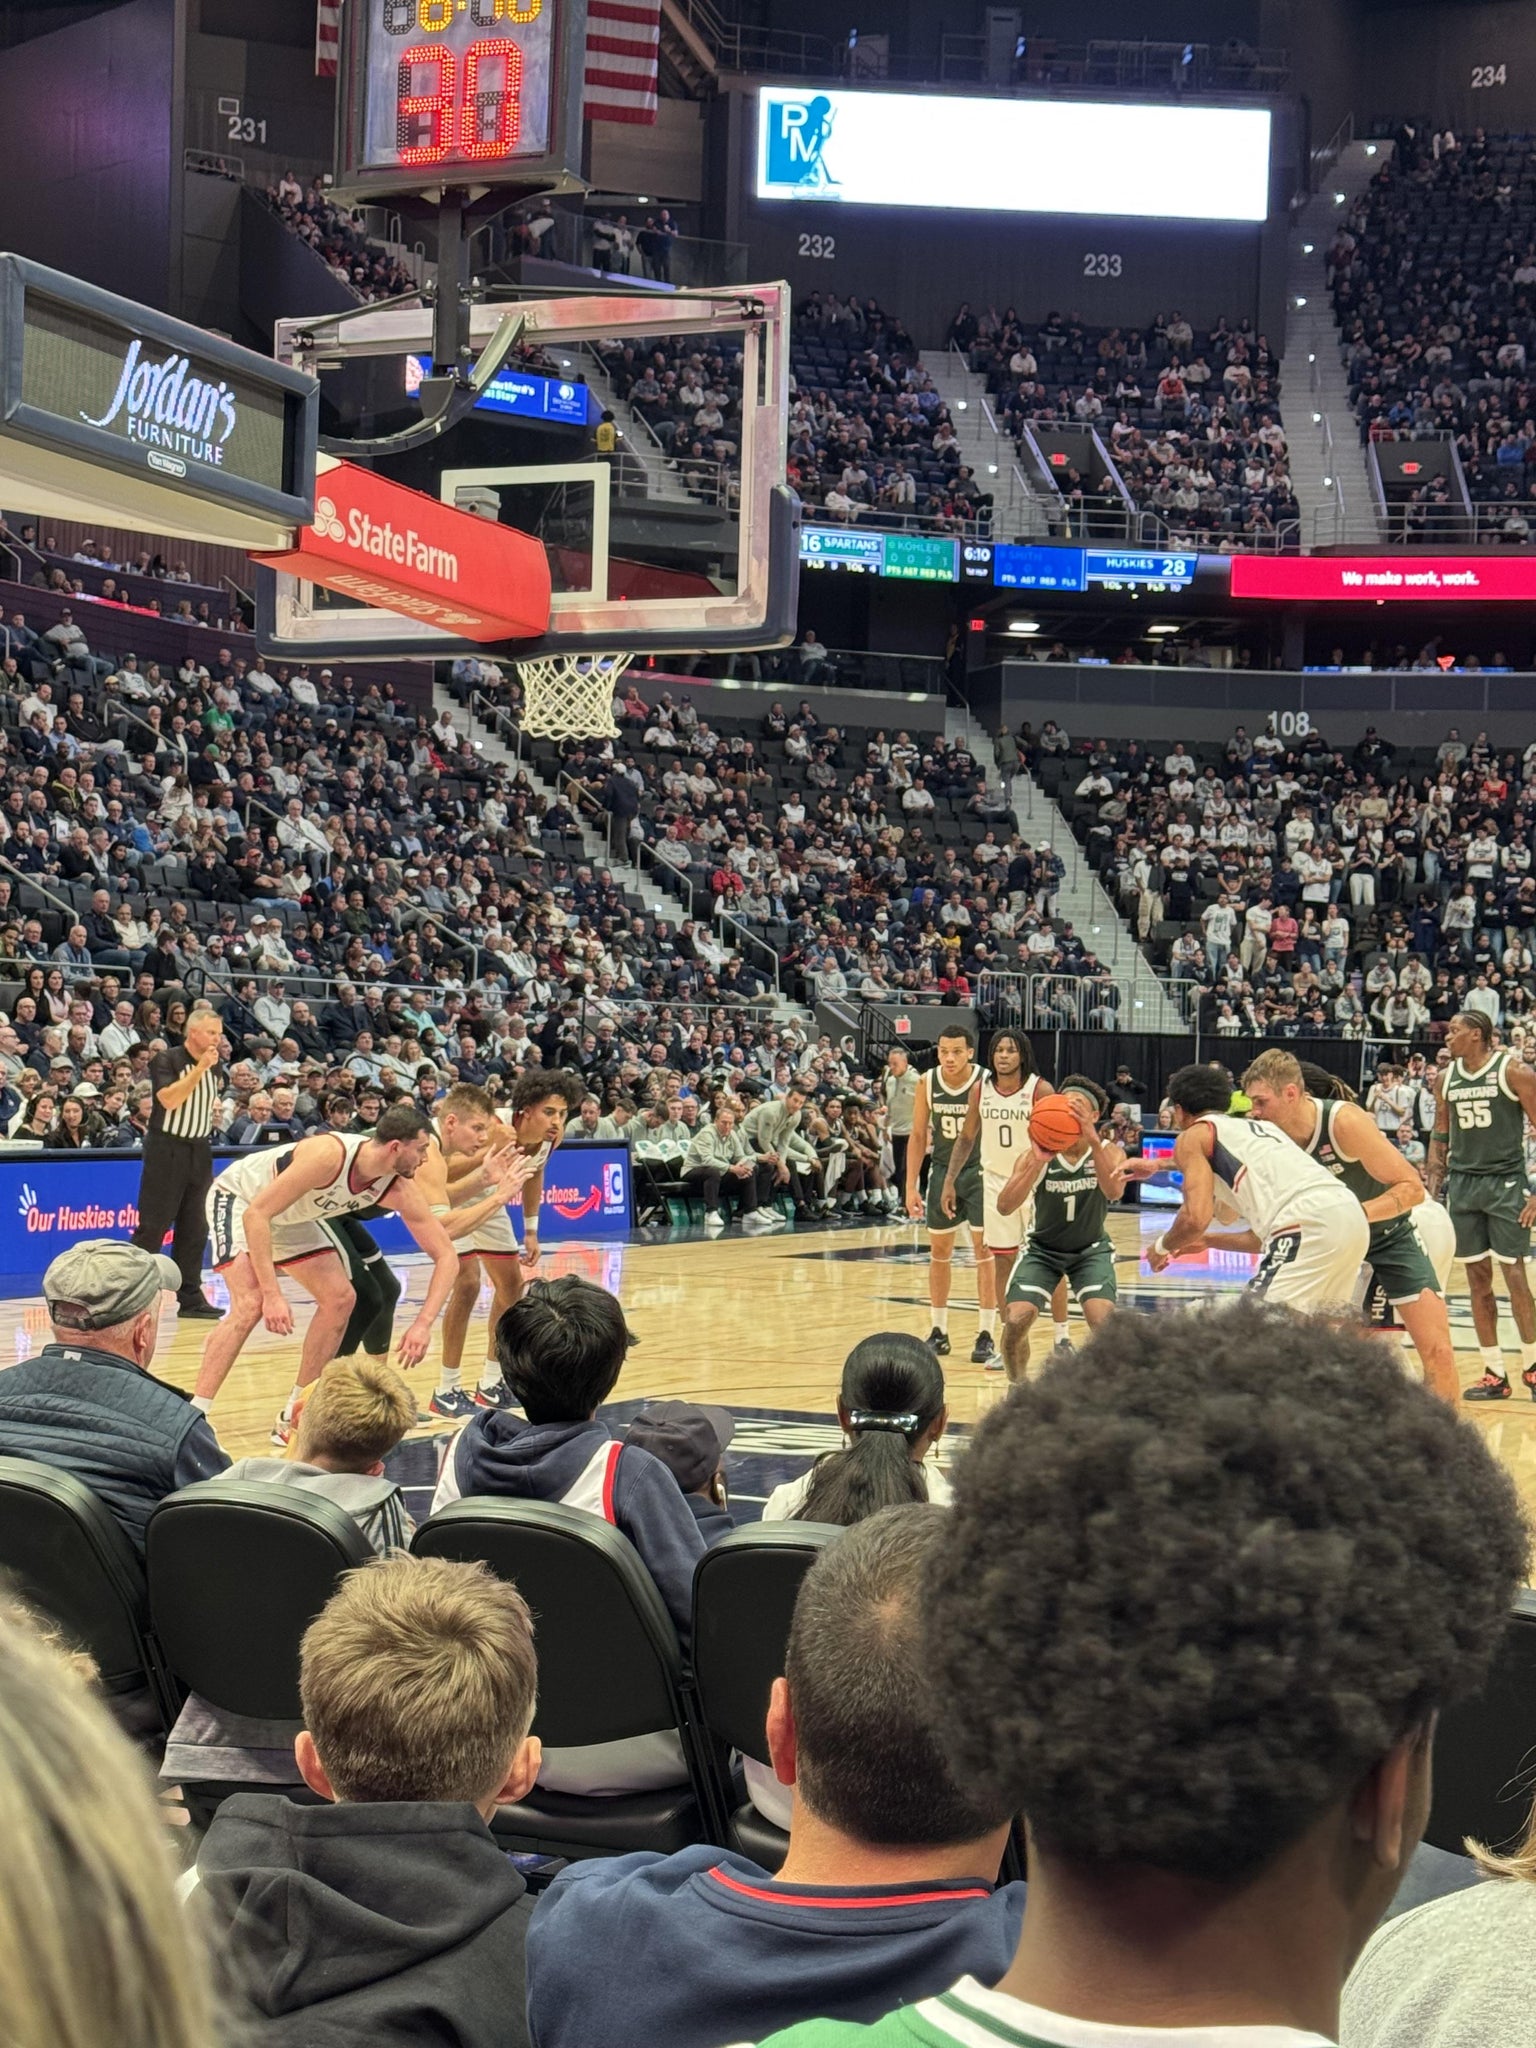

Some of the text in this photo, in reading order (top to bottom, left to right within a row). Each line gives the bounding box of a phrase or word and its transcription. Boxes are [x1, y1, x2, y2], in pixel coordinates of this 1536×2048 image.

[1471, 64, 1506, 88] 234
[398, 38, 522, 166] 30
[228, 116, 267, 143] 231
[798, 233, 835, 258] 232
[1084, 253, 1122, 276] 233
[79, 339, 236, 443] Jordan's
[127, 416, 224, 466] FURNITURE
[801, 534, 821, 552] 16
[824, 537, 878, 552] SPARTANS
[963, 547, 991, 562] 6:10
[1106, 557, 1186, 576] HUSKIES 28
[1341, 571, 1480, 587] We make work, work.
[1267, 711, 1310, 737] 108
[1448, 1085, 1499, 1102] SPARTANS
[982, 1108, 1031, 1121] UCONN
[1455, 1100, 1492, 1130] 55
[999, 1124, 1013, 1148] 0
[1045, 1177, 1098, 1193] SPARTANS
[27, 1206, 56, 1233] Our
[57, 1204, 115, 1231] Huskies
[1063, 1195, 1076, 1222] 1
[216, 1190, 231, 1258] HUSKIES
